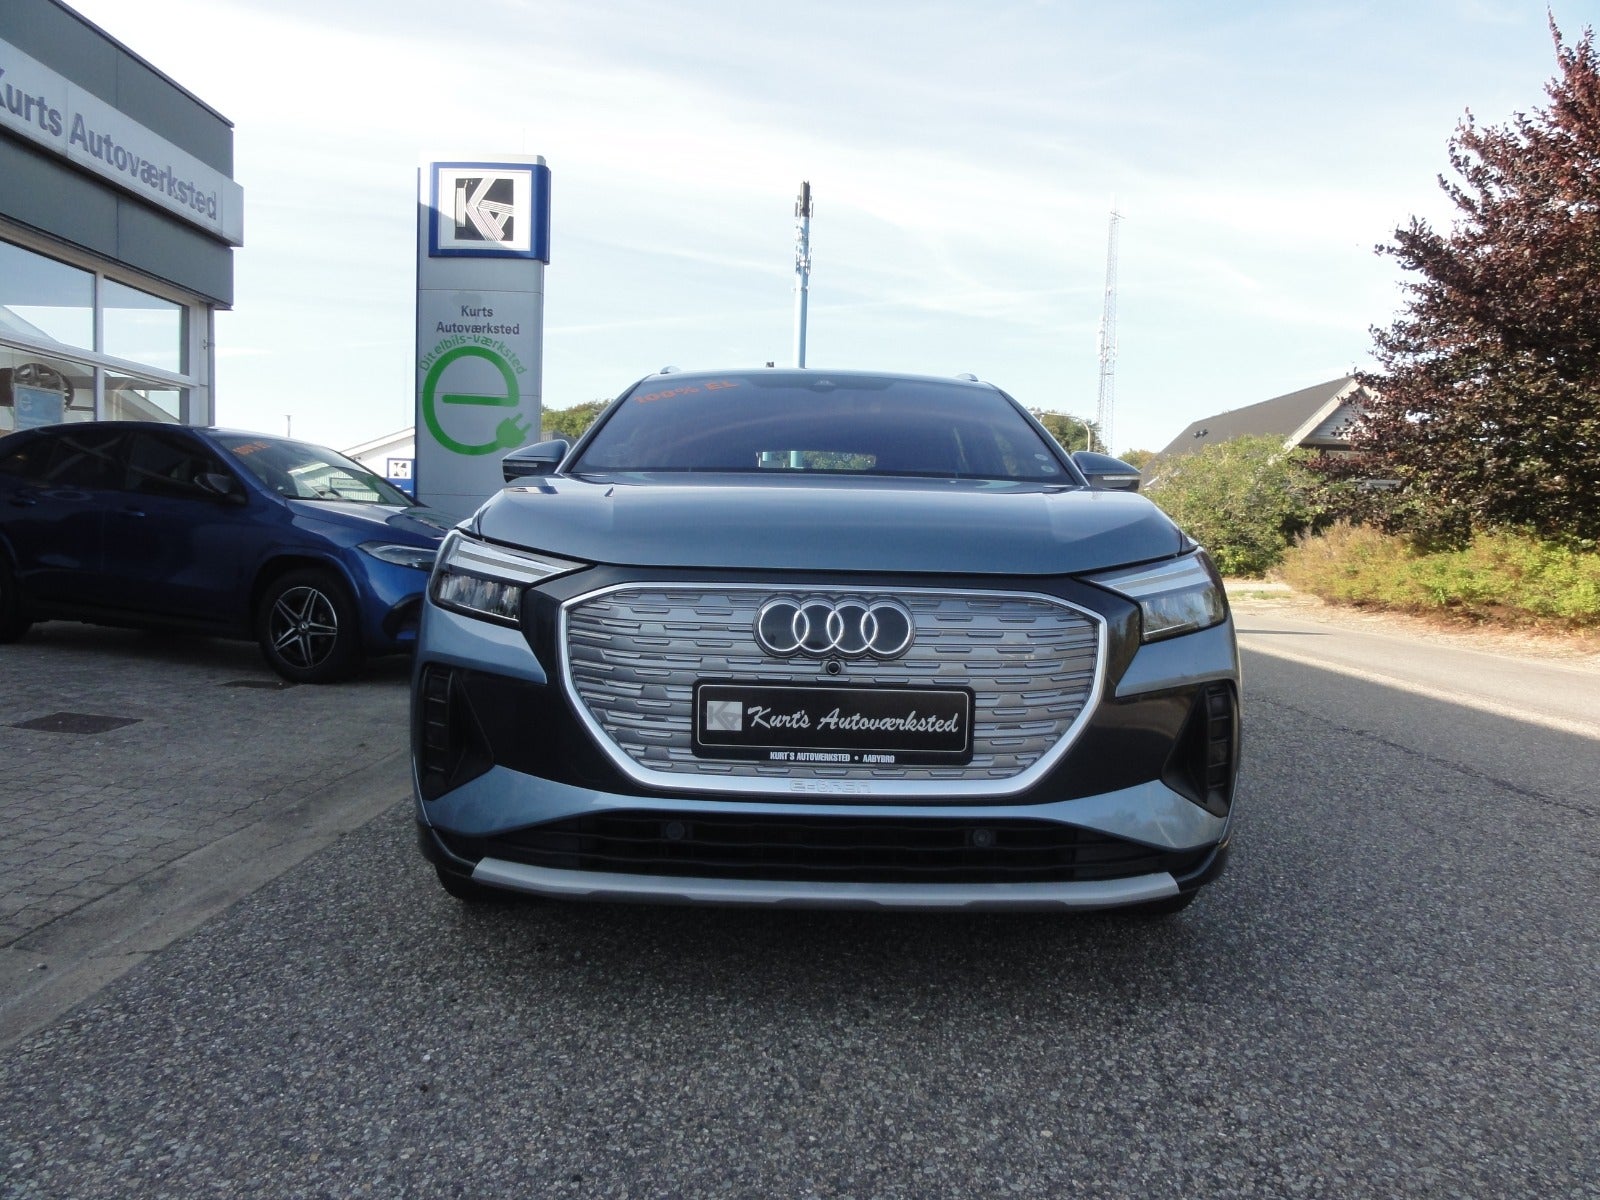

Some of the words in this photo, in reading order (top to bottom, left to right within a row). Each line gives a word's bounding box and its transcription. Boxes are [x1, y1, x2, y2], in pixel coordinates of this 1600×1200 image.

[69, 112, 217, 220] Autoværksted
[461, 305, 494, 317] Kurts
[436, 321, 520, 335] Autoværksted
[747, 705, 811, 729] Kurt's
[817, 707, 959, 733] Autoværksted
[862, 755, 896, 764] AABYBRO
